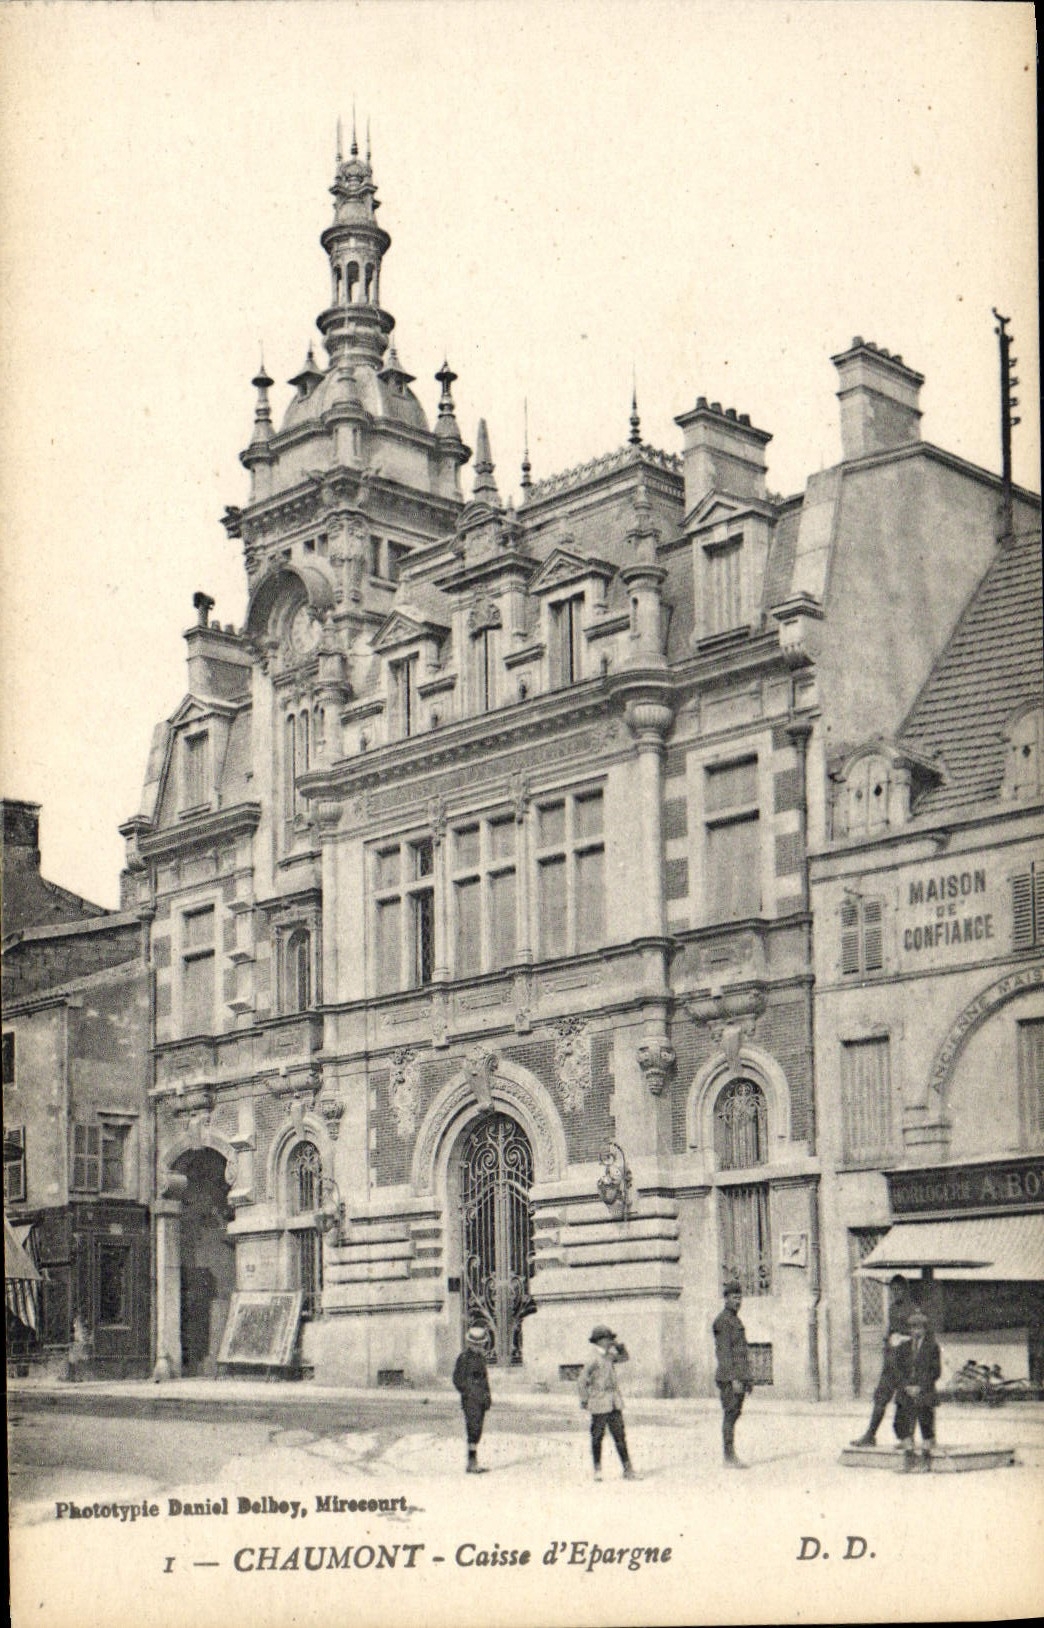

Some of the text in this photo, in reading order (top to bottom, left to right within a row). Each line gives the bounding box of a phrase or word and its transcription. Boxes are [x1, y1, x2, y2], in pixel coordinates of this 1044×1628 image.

[908, 868, 986, 905] MAISON
[936, 903, 957, 917] DE
[903, 914, 995, 952] CONFIANCE
